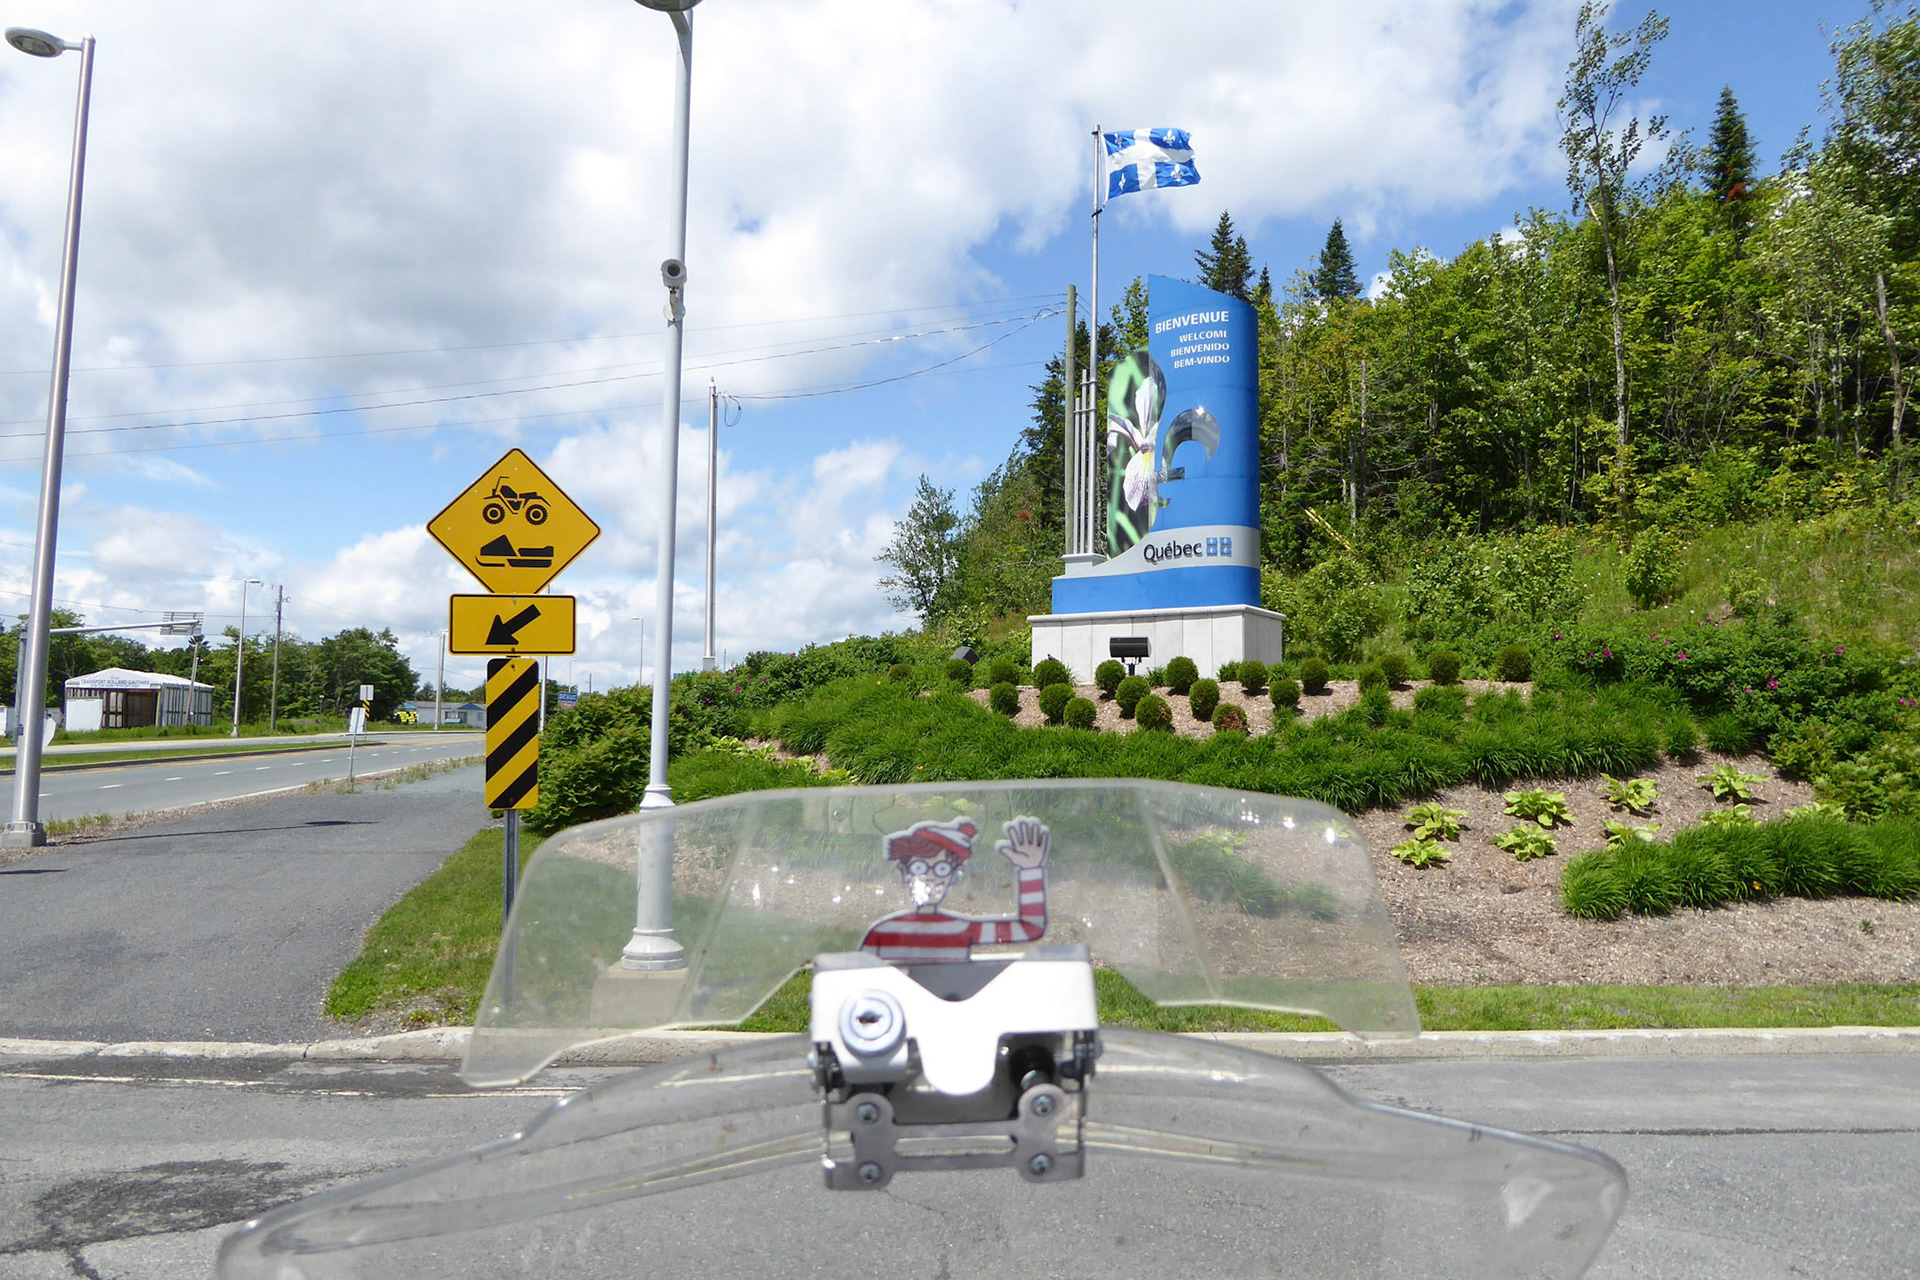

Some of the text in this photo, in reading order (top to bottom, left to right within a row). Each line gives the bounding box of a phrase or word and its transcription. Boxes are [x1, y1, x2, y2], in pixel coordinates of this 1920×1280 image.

[1155, 311, 1230, 334] BIENVENUE
[1170, 342, 1230, 357] BIENVENIDO
[1174, 355, 1230, 369] BEM-VINDO
[1143, 540, 1203, 564] Québec
